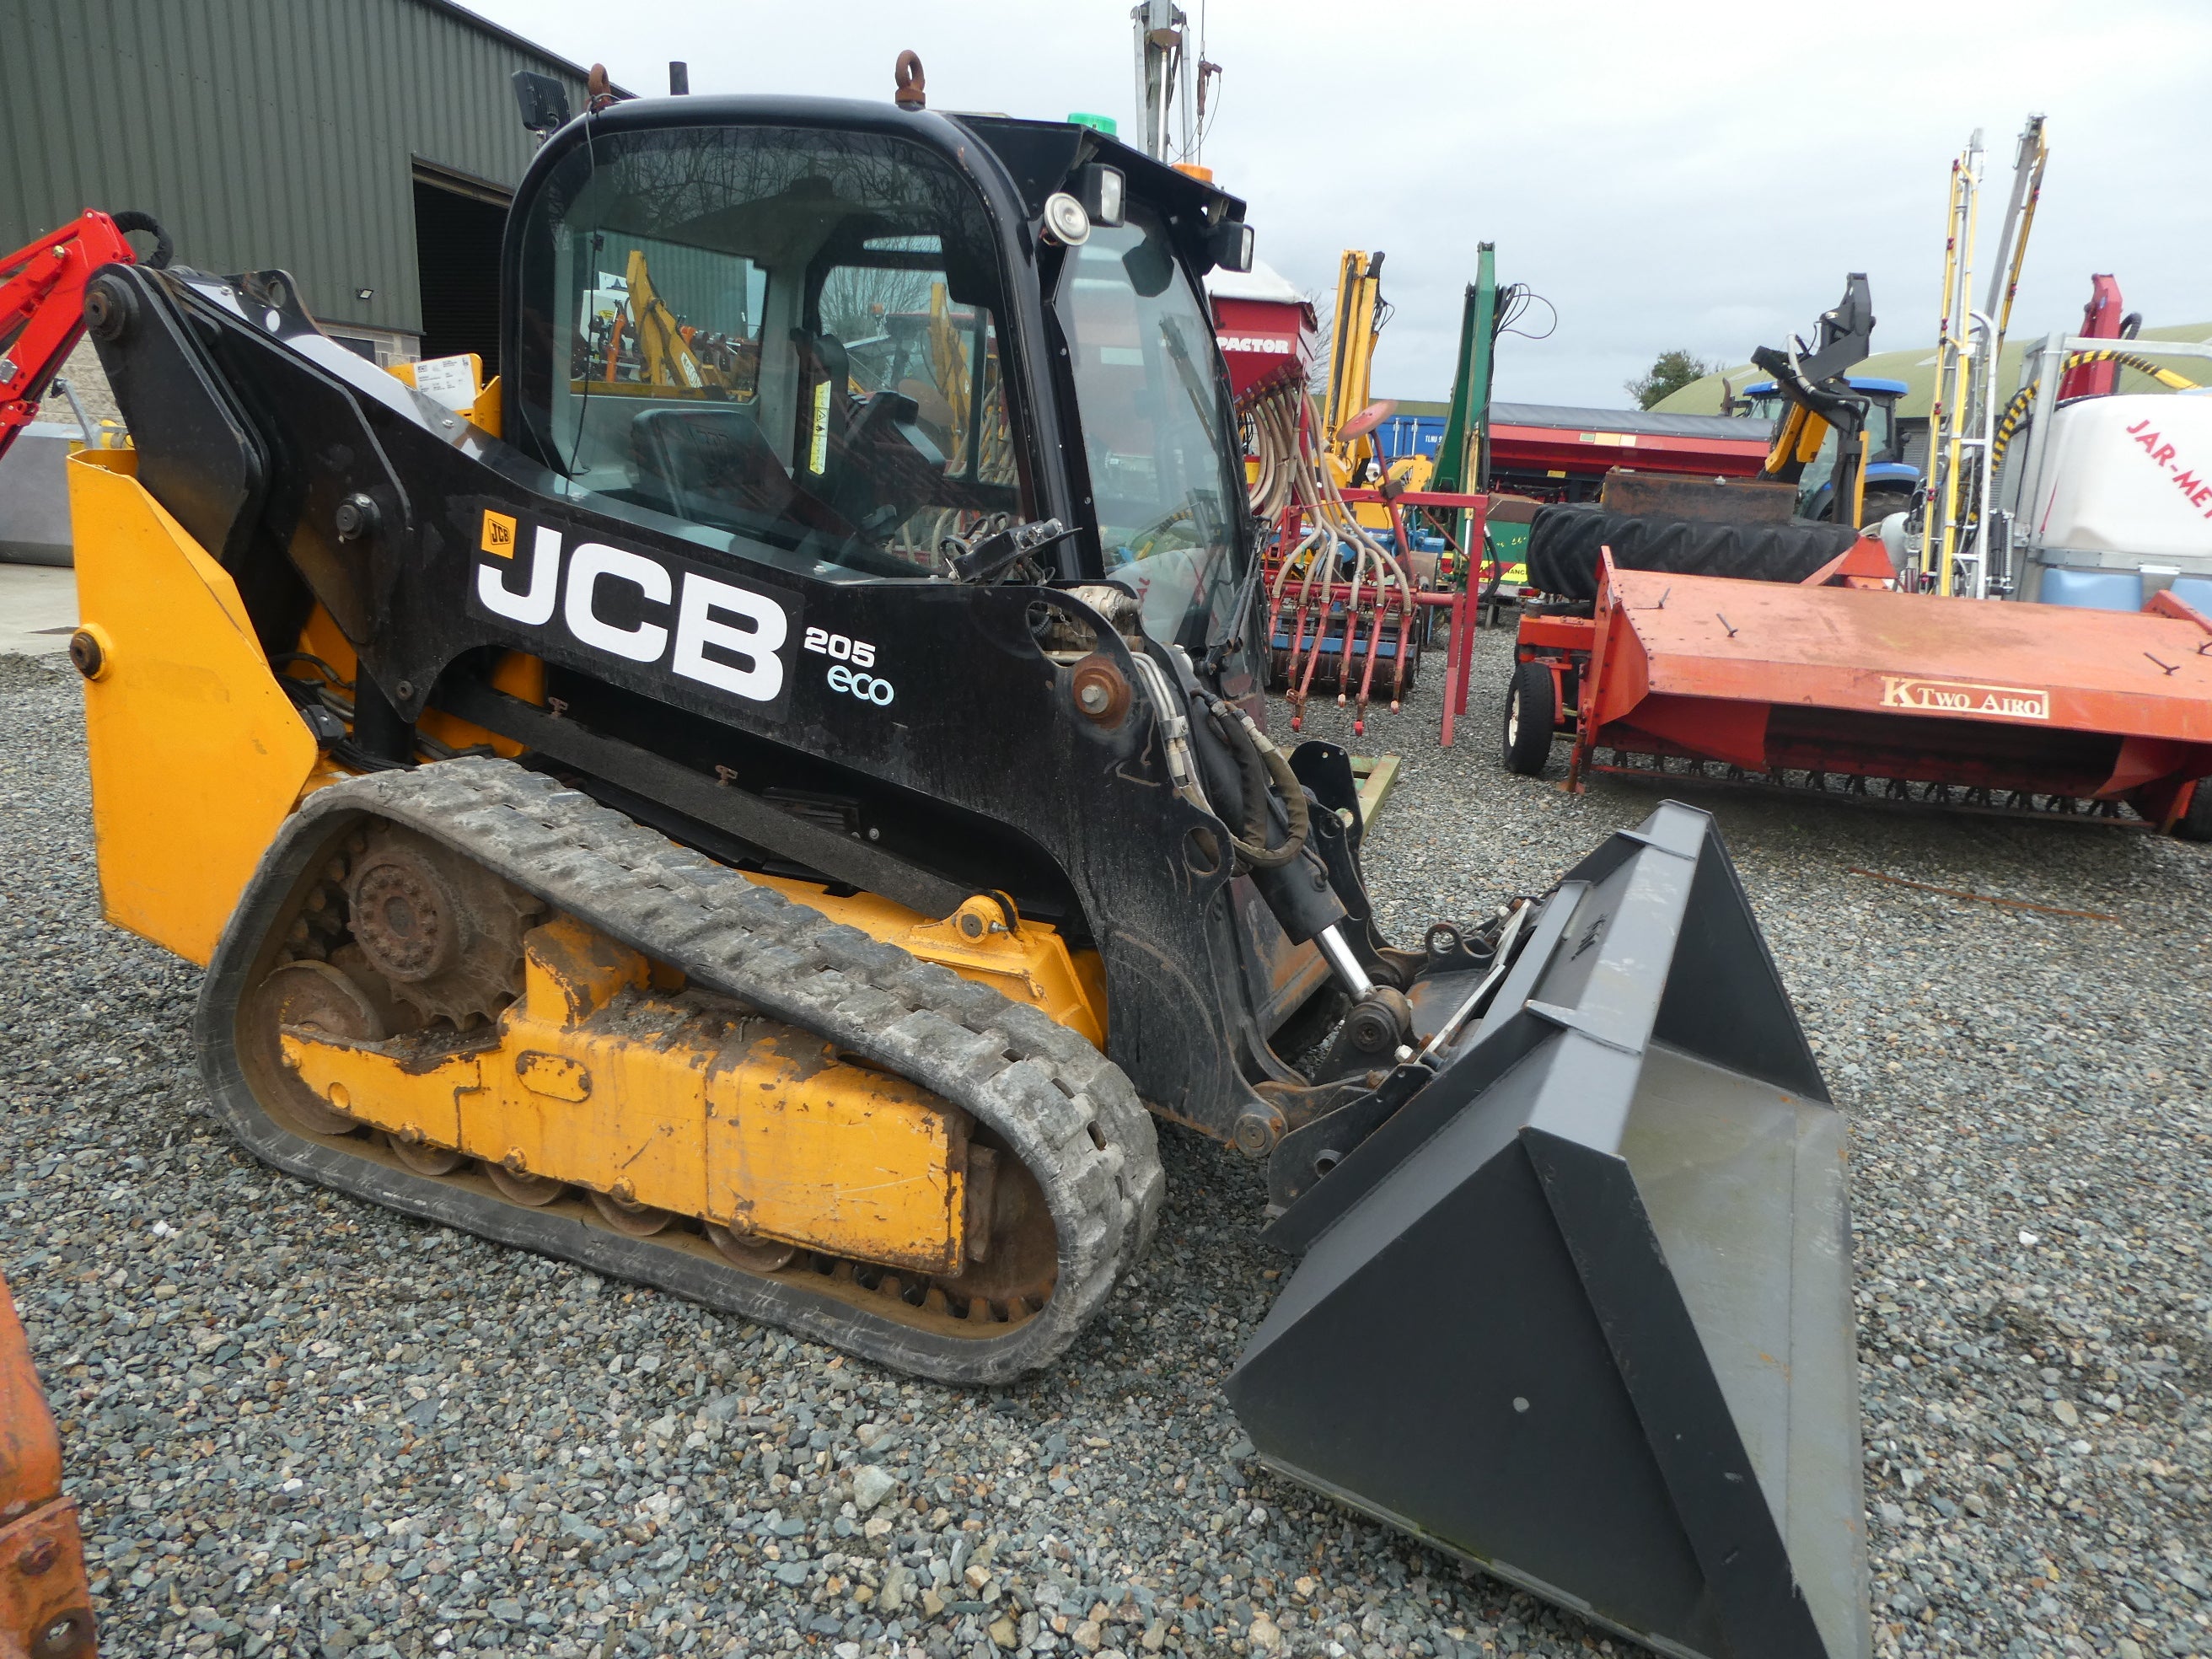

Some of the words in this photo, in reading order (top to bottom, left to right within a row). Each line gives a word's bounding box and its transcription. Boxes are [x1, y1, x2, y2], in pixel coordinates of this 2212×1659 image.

[1216, 336, 1289, 354] PACTOR
[491, 522, 509, 543] JCB
[478, 525, 788, 702] JCB
[803, 626, 876, 668] 205
[827, 664, 894, 706] eco
